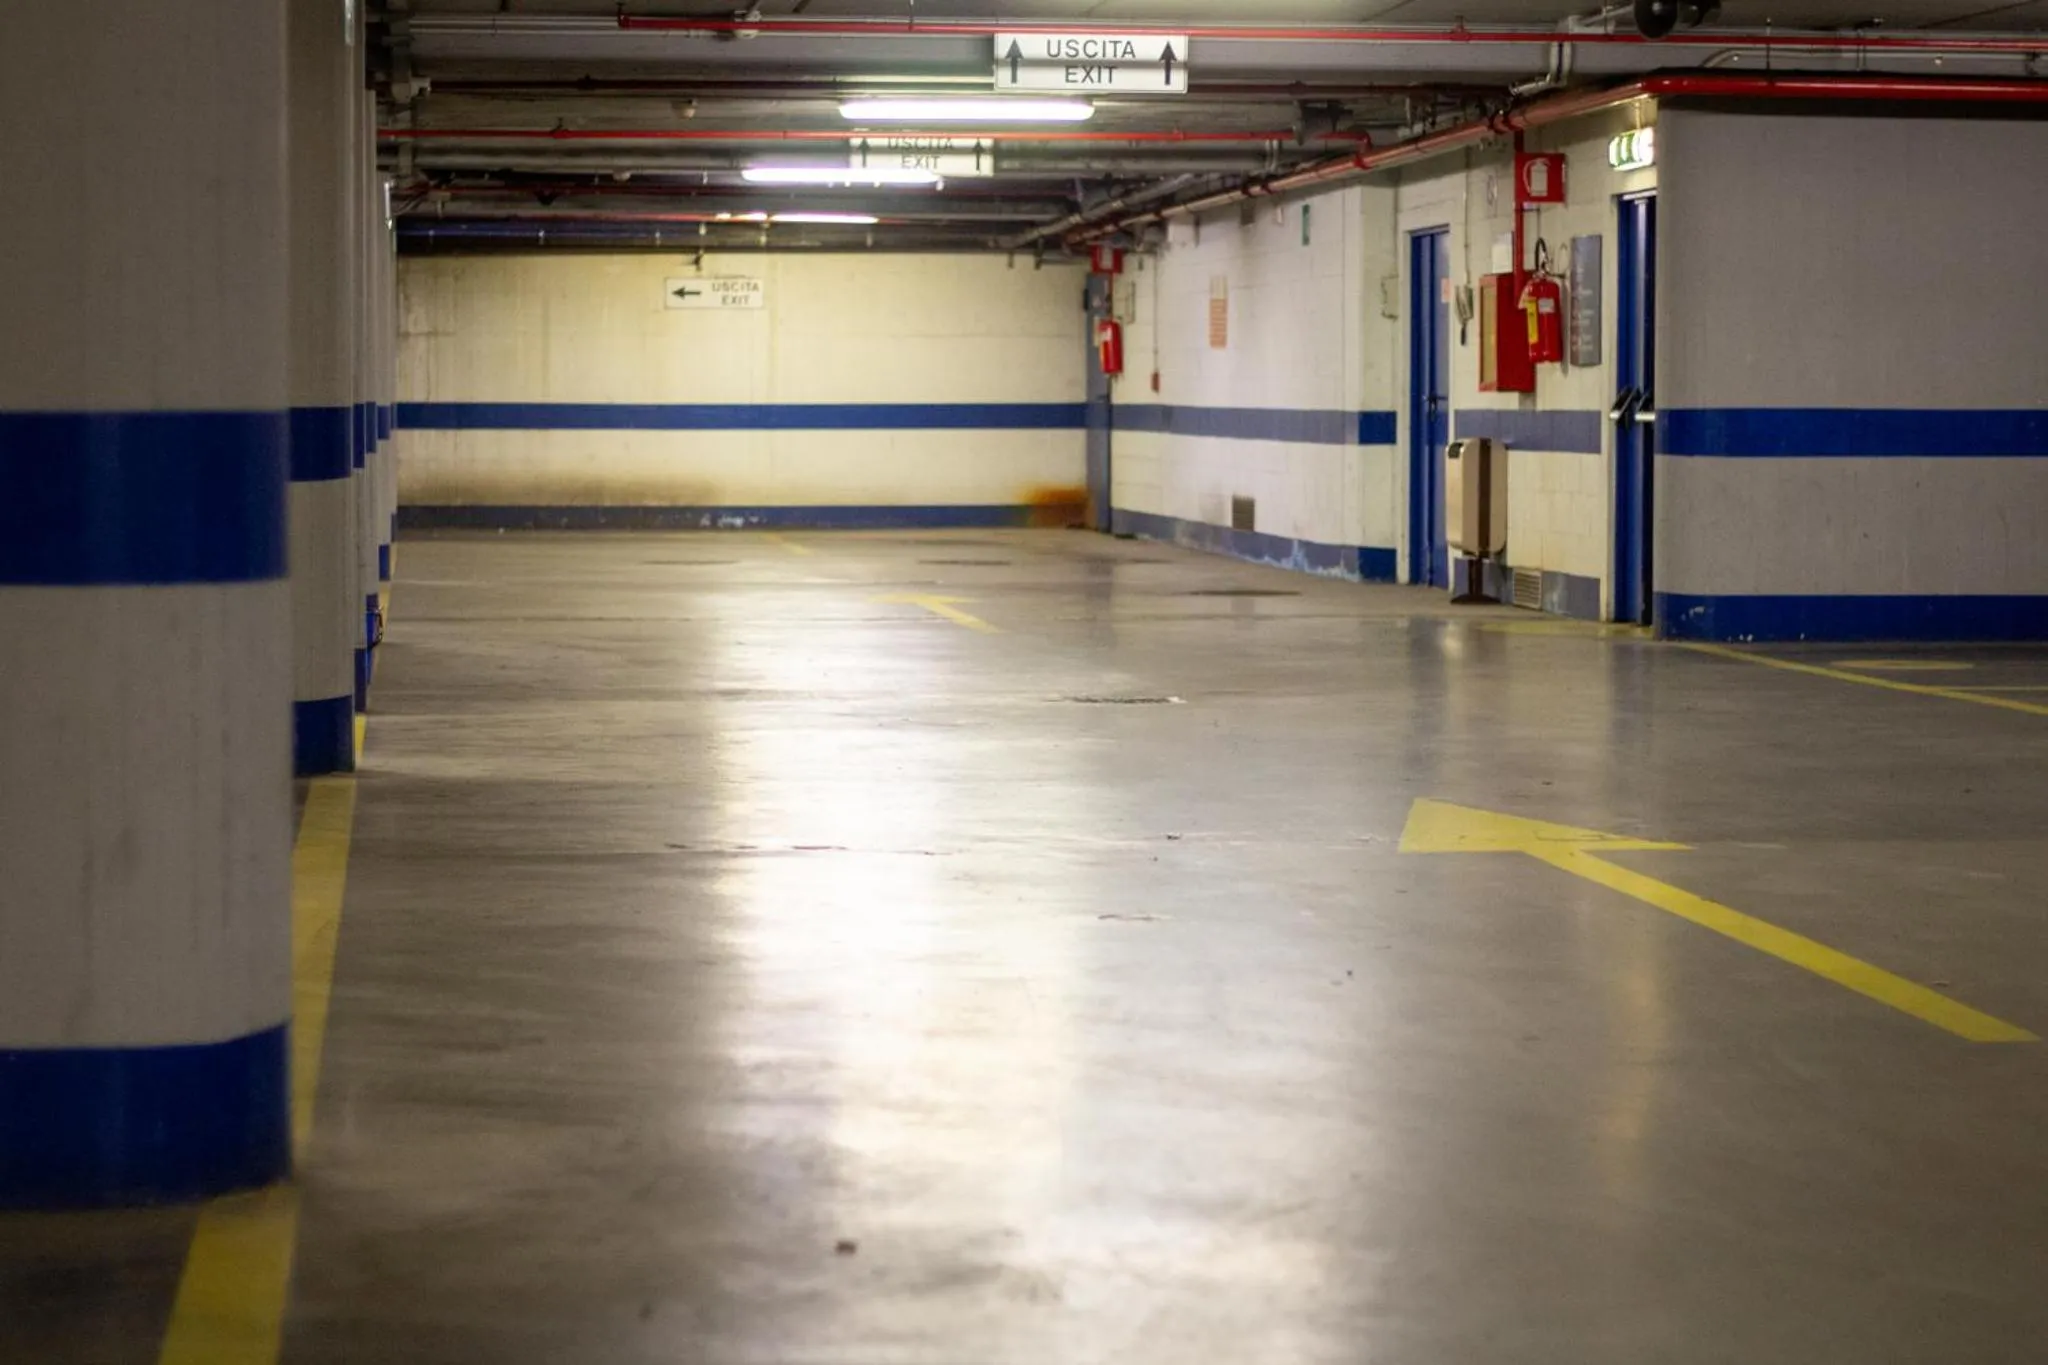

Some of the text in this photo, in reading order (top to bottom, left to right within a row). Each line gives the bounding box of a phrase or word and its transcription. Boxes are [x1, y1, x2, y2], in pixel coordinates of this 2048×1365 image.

[1046, 39, 1136, 59] USCITA
[1064, 65, 1118, 84] EXIT
[901, 154, 941, 170] EXIT
[711, 281, 760, 293] USCITA
[721, 294, 751, 306] EXIT
